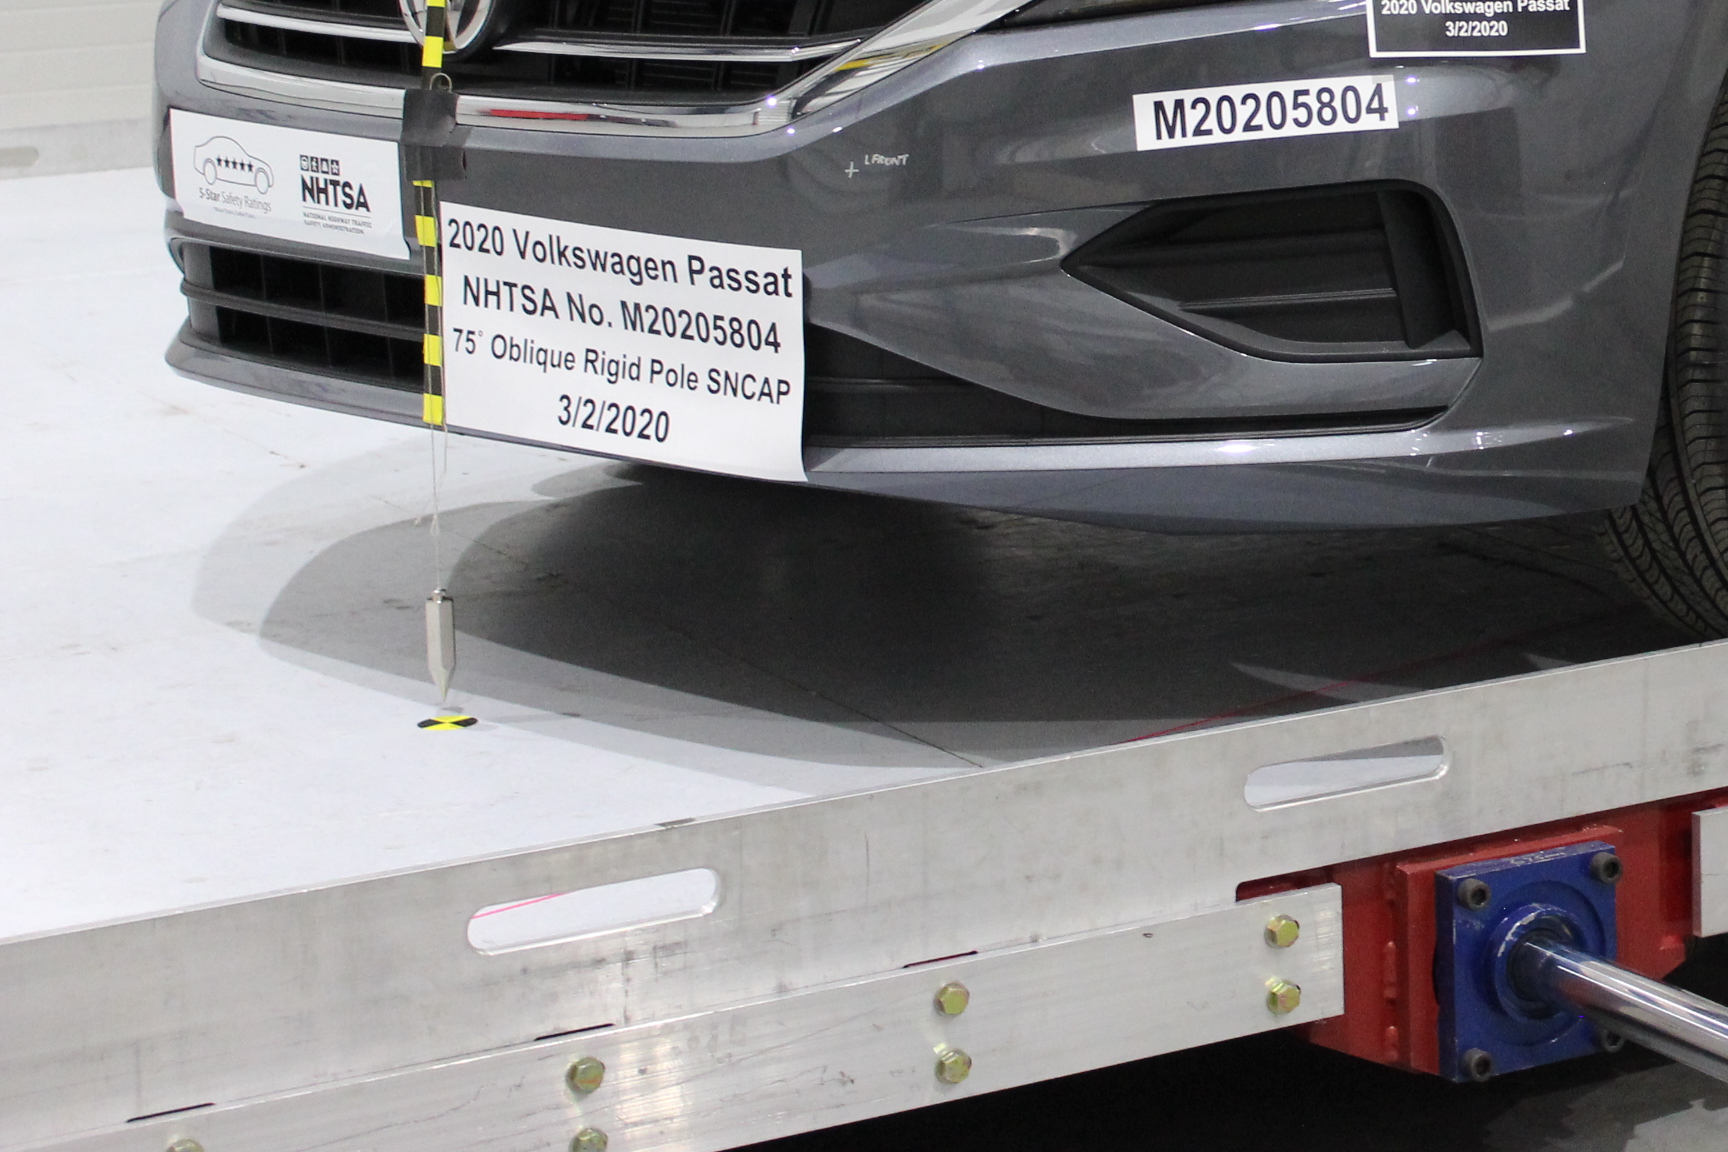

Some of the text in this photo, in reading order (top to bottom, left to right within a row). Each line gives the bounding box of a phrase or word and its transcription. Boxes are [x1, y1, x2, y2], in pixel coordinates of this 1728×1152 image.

[1381, 0, 1418, 15] 2020
[1445, 21, 1508, 37] 3/2/2020
[1153, 82, 1389, 141] M20205804
[199, 187, 220, 202] 5-Star
[221, 191, 243, 209] Safety
[243, 195, 272, 214] Ratings
[300, 174, 372, 213] NHTSA
[448, 218, 793, 298] 2020 Volkswagen Passat
[463, 274, 782, 354] NHTSA No. M20205804
[491, 334, 577, 372] Oblique
[584, 348, 642, 385] Rigid
[649, 358, 700, 391] Pole
[707, 368, 792, 405] SNCAP
[557, 393, 670, 443] 3/2/2020
